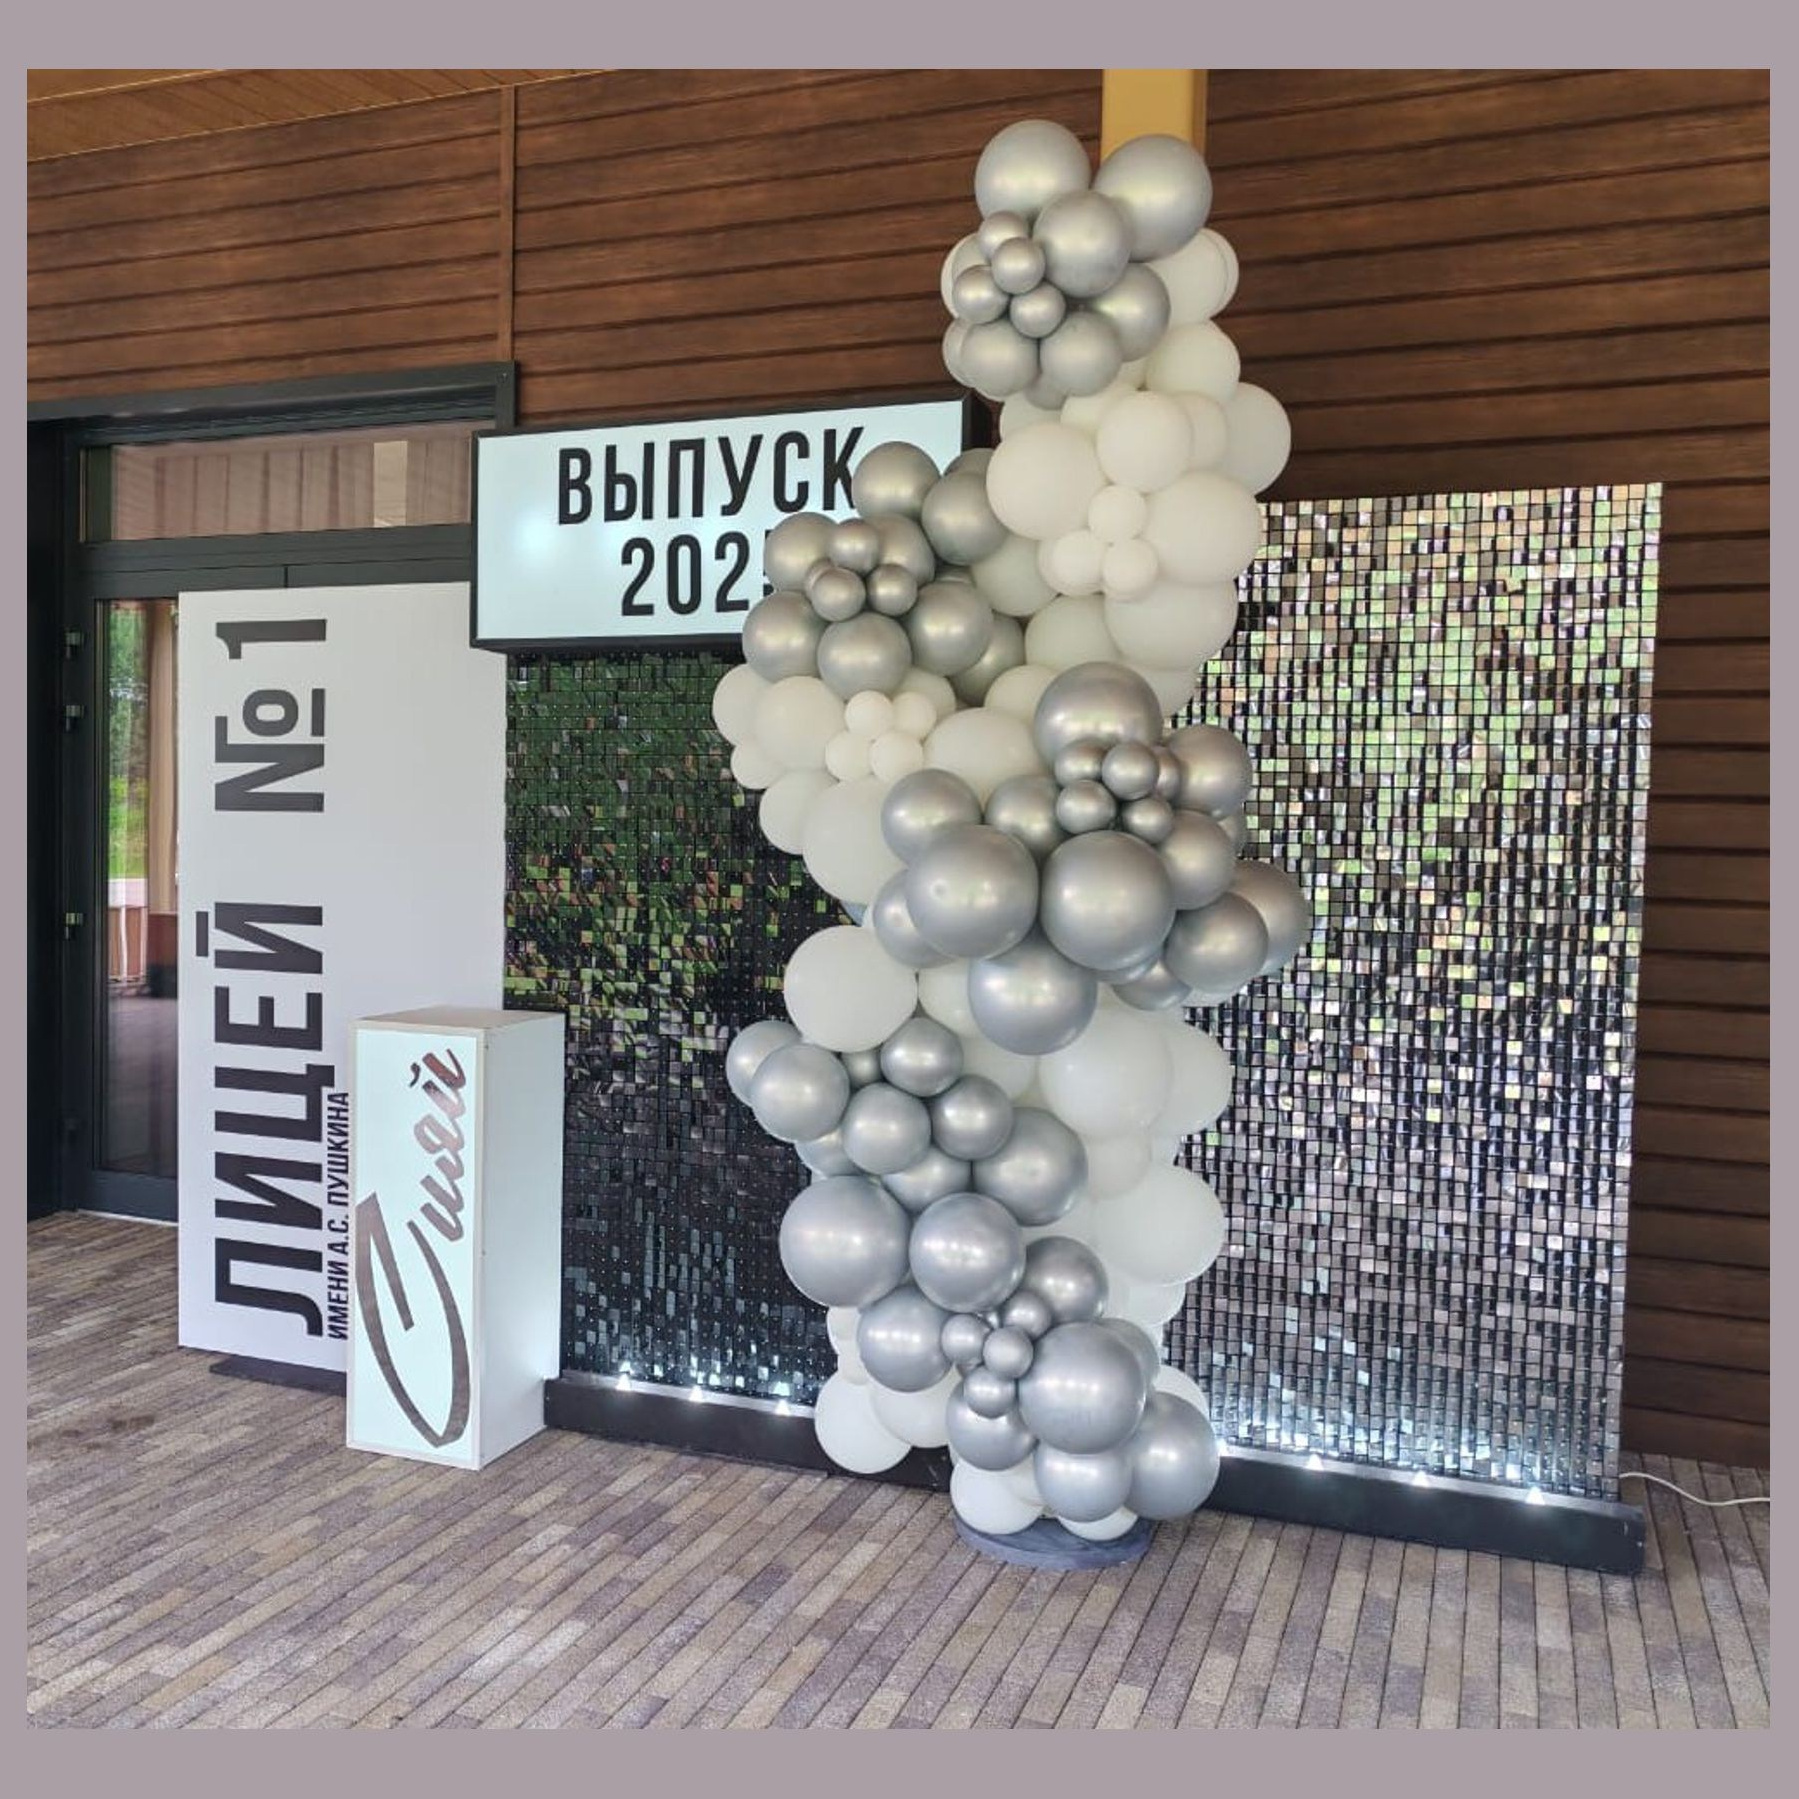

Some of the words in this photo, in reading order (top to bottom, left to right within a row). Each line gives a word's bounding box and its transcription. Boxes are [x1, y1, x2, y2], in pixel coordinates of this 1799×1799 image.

[558, 427, 864, 525] ВЫПУСК
[621, 530, 775, 616] 202
[196, 902, 335, 1337] ЛИЦЕЙ
[327, 1092, 349, 1207] ПУШКИНА
[327, 1214, 349, 1255] А.С.
[355, 1048, 470, 1447] Сияй
[327, 1260, 349, 1340] ИМЕНИ
